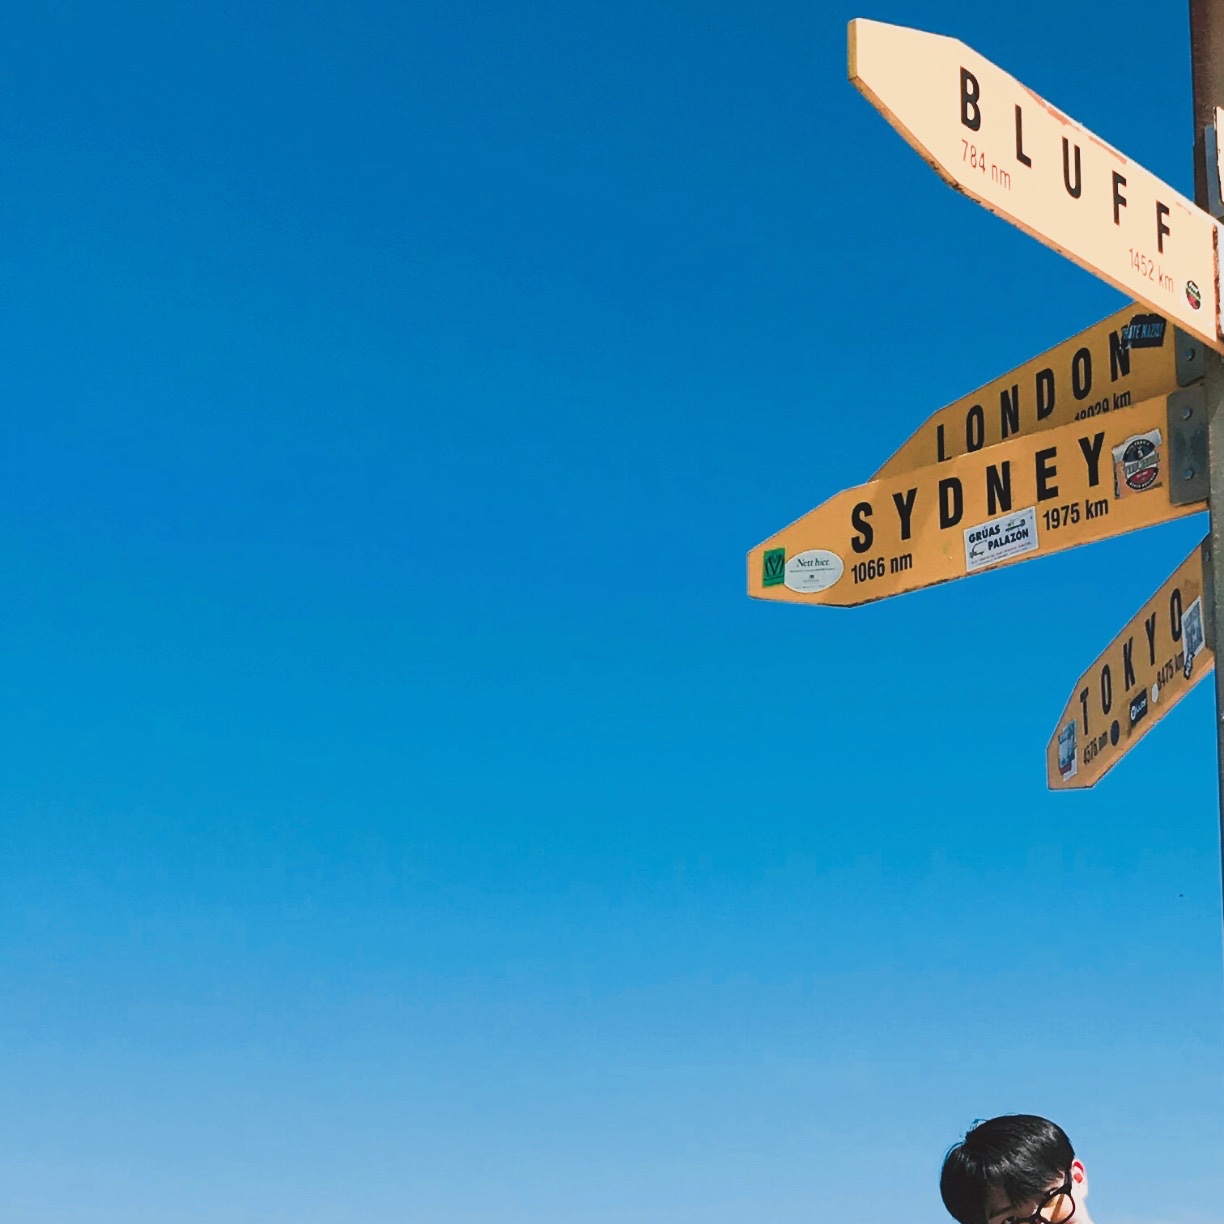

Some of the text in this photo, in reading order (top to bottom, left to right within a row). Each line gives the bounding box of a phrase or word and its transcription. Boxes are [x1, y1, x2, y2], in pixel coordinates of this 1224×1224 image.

[960, 66, 1171, 254] BLUFF
[961, 138, 1011, 191] 784 nm
[1128, 248, 1154, 282] 1452
[1158, 265, 1173, 294] km
[937, 330, 1131, 462] LONDON
[1113, 390, 1131, 410] km
[851, 432, 1105, 554] SYDNEY
[1043, 498, 1109, 531] 1975 km
[968, 524, 1001, 544] GRÚAS
[988, 527, 1029, 551] PALAZÓN
[851, 553, 913, 585] 1066 nm
[1080, 588, 1183, 735] TOKYO
